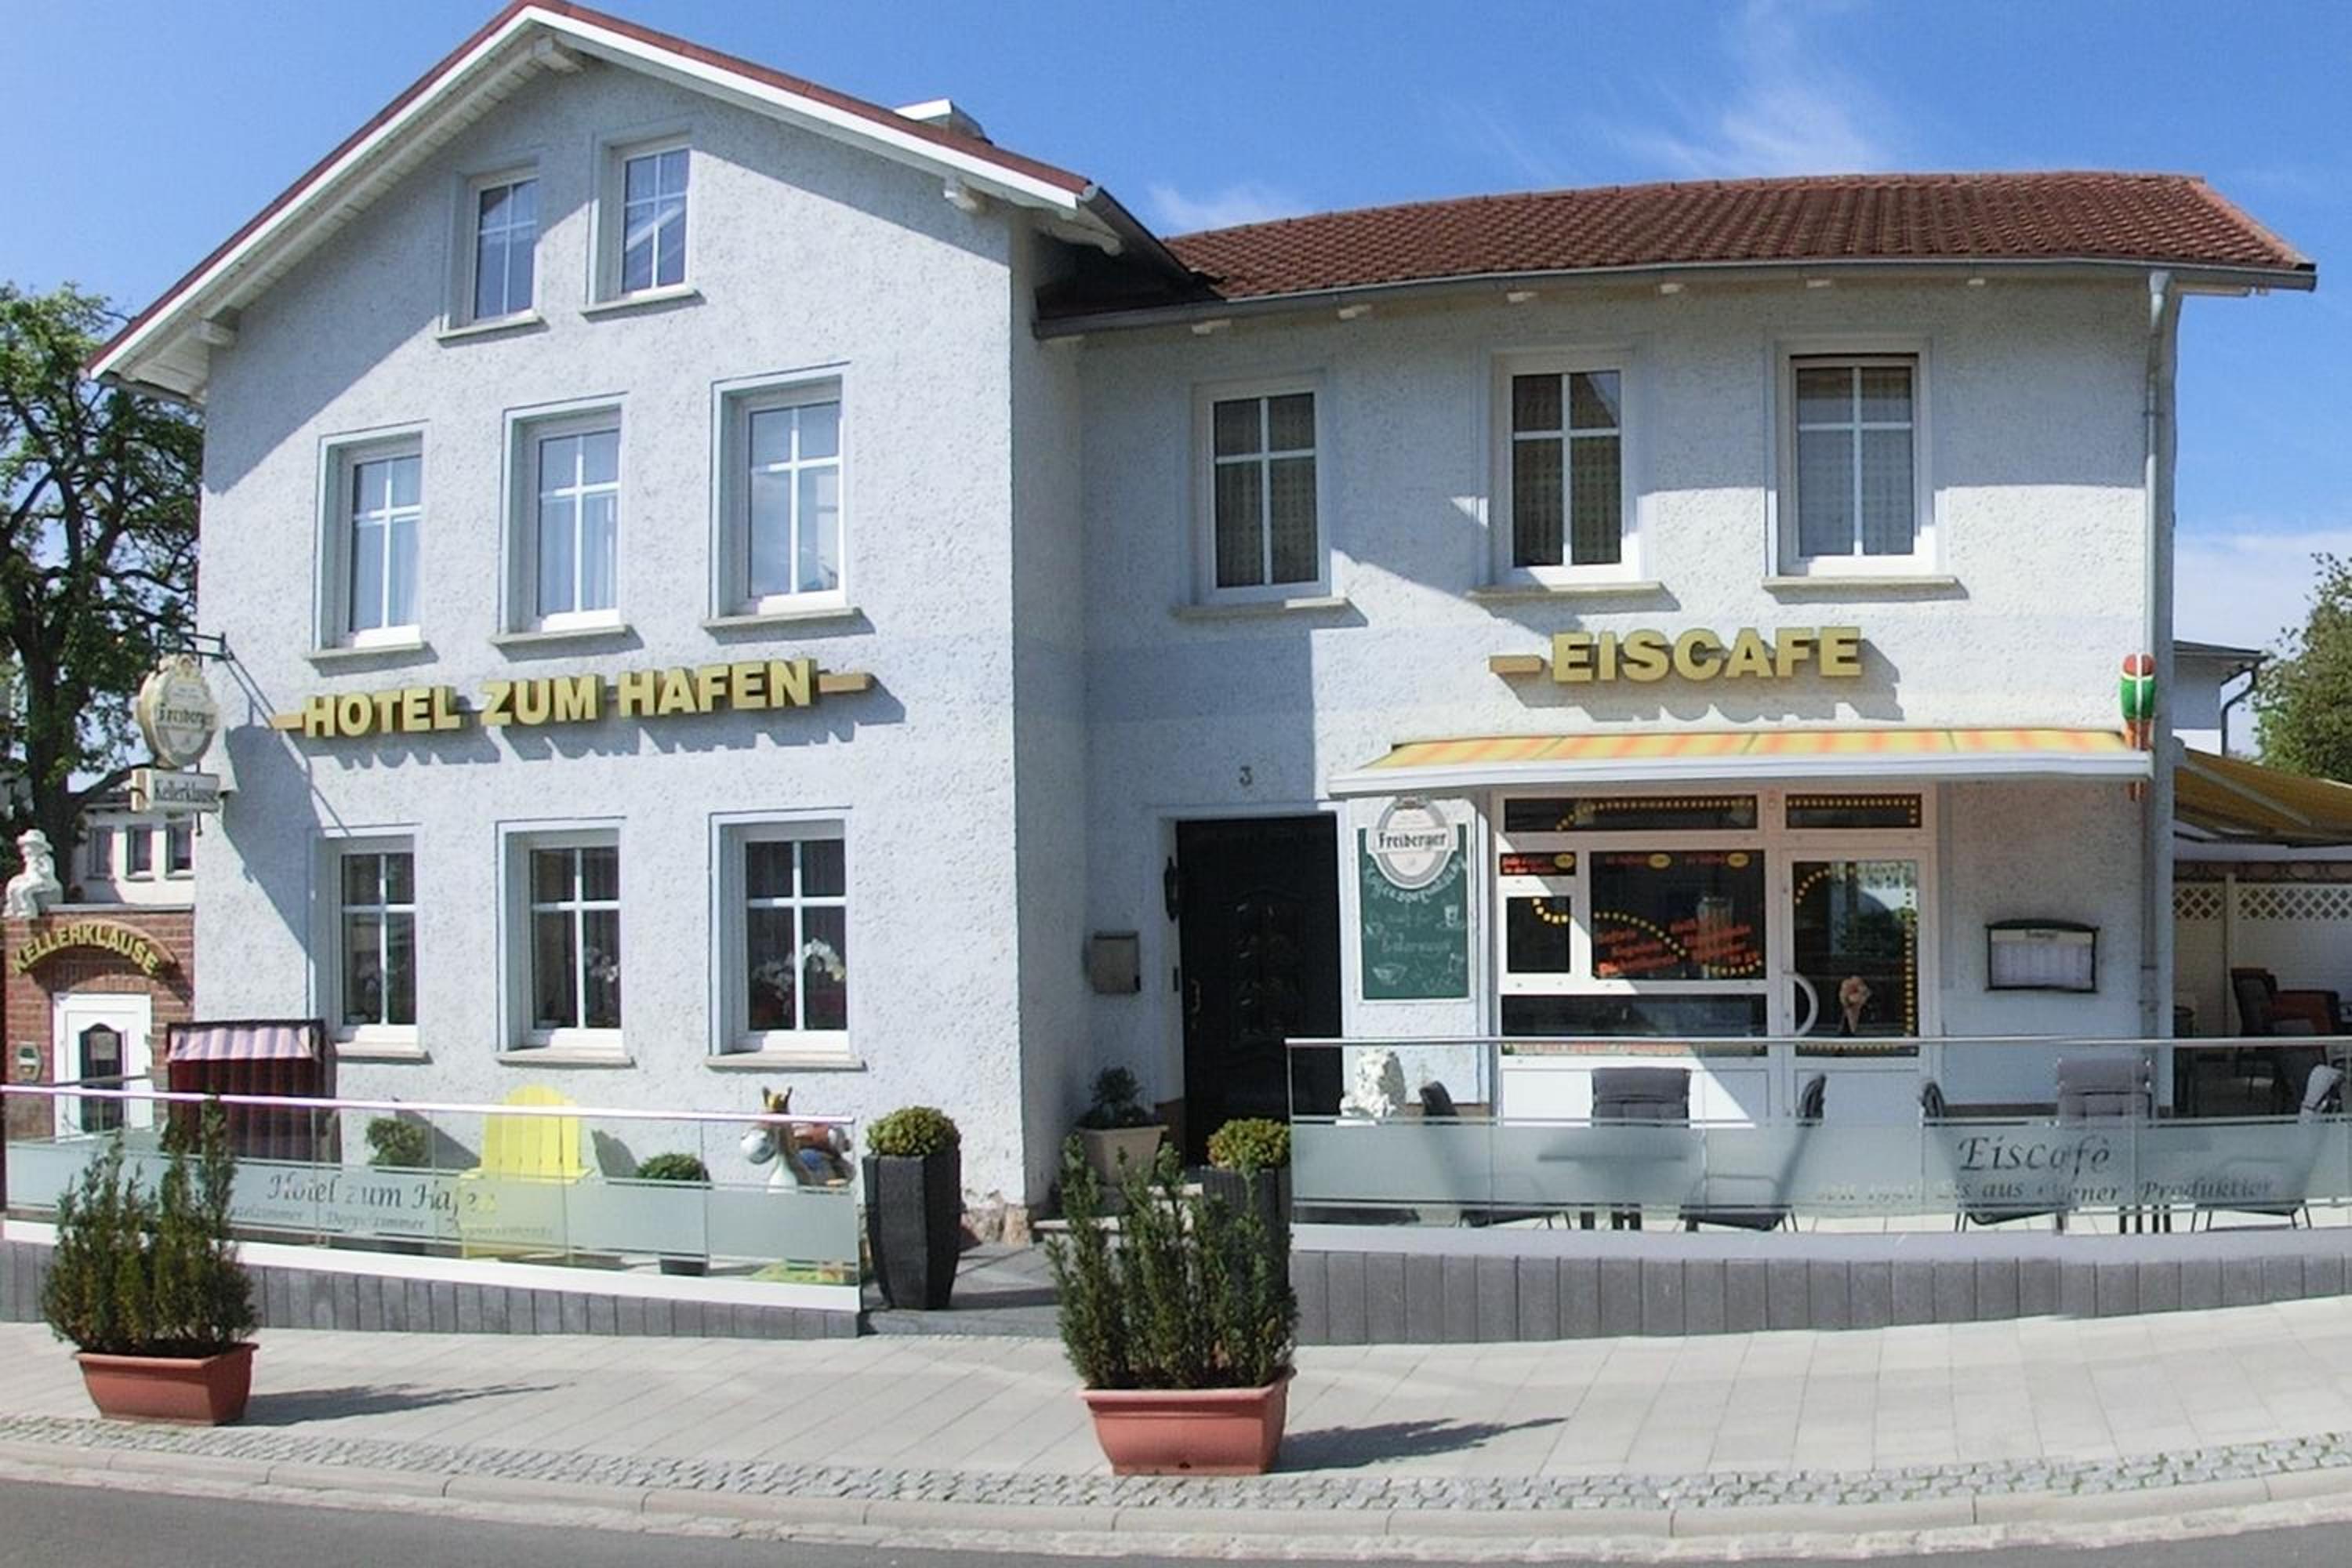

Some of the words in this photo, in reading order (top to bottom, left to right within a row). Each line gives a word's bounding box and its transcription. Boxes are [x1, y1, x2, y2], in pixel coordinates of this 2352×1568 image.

[1553, 626, 1862, 684] EISCAFE
[304, 684, 463, 739] HOTEL
[480, 673, 604, 728] ZUM
[617, 659, 818, 716] HAFEN
[1239, 764, 1253, 788] 3
[13, 923, 159, 975] KELLERKLAUSE
[346, 1181, 401, 1208] zum
